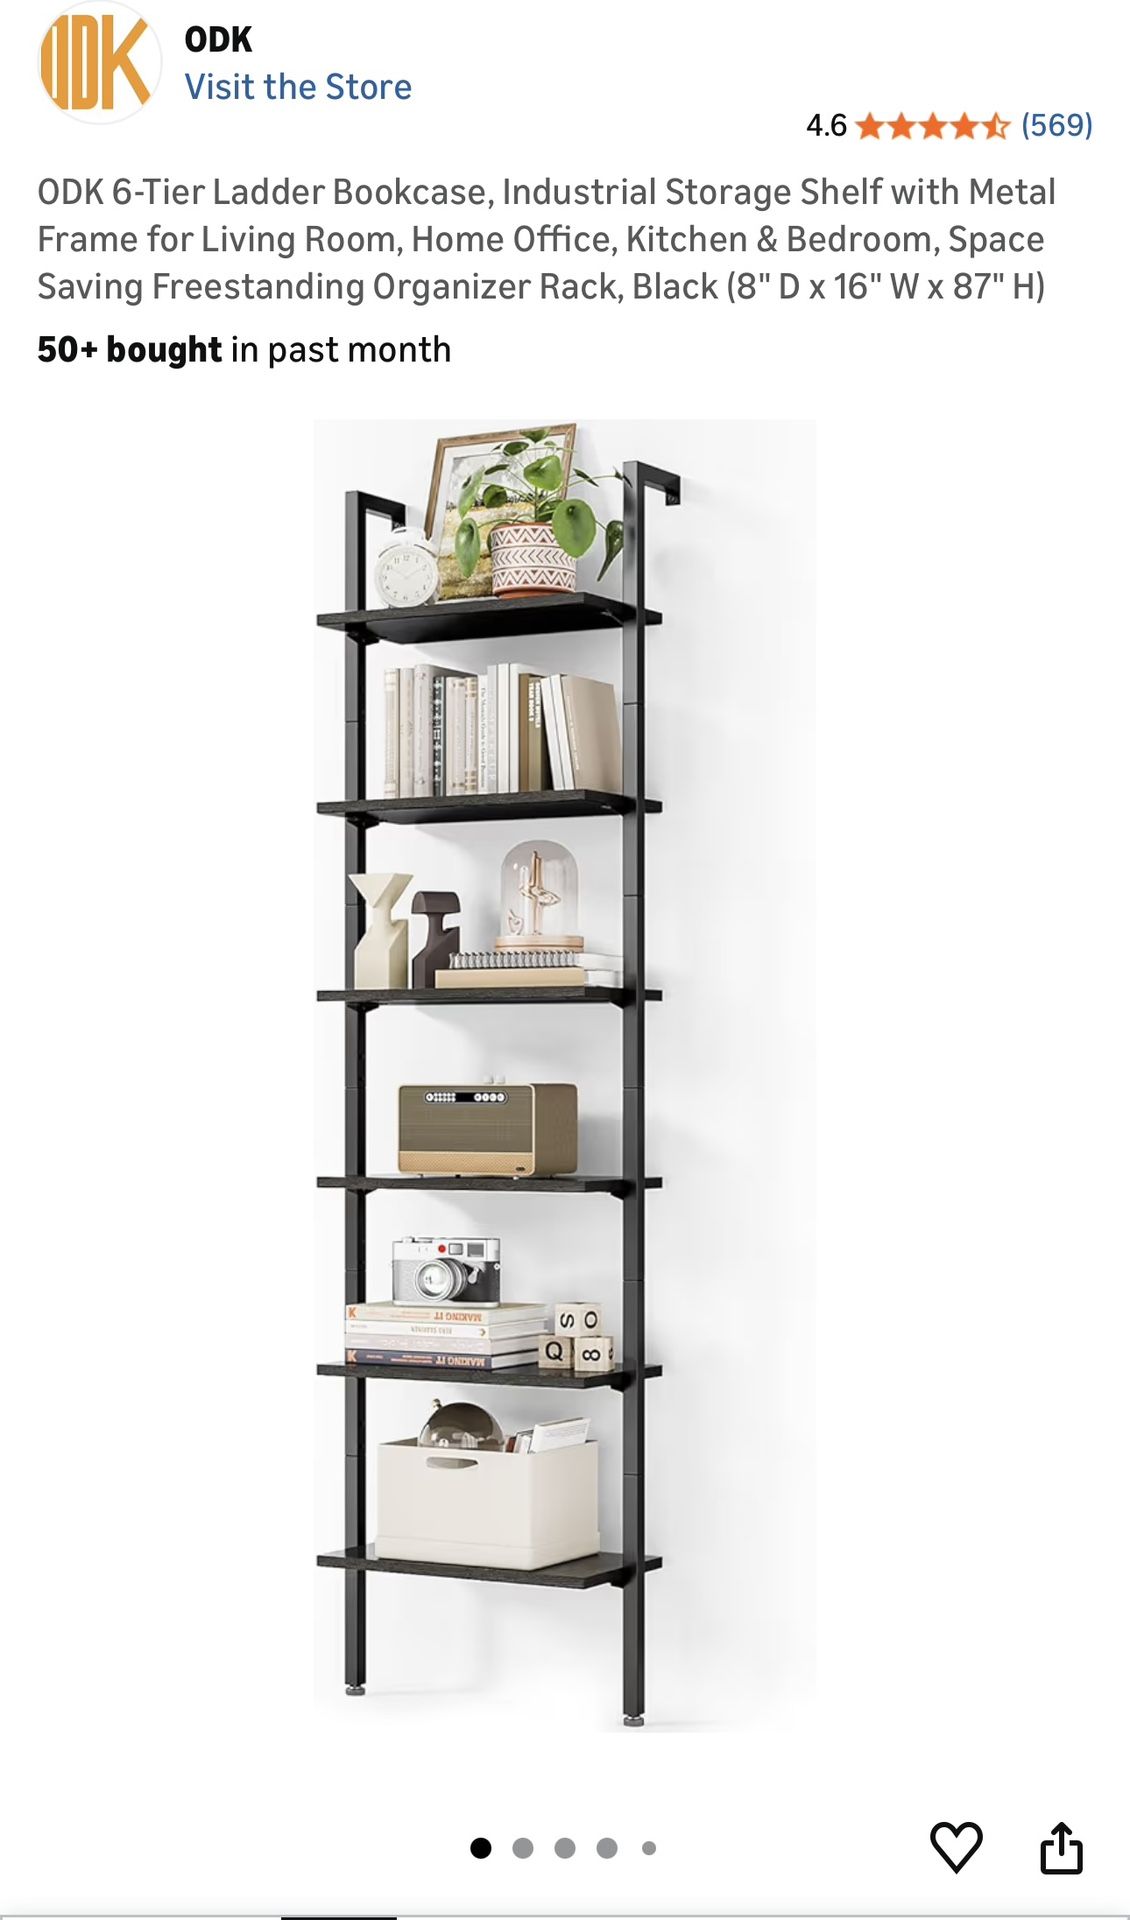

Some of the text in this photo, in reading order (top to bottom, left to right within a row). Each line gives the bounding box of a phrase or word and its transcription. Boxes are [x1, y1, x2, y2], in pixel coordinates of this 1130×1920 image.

[185, 25, 253, 53] ODK
[41, 15, 151, 110] ODK
[185, 72, 411, 100] Visit the Store
[806, 113, 847, 138] 4.6
[1022, 111, 1093, 141] (569)
[38, 177, 1056, 211] ODK 6-Tier Ladder Bookcase, Industrial Storage Shelf with Metal
[39, 224, 1044, 259] Frame for Living Room, Home Office, Kitchen & Bedroom, Space
[38, 271, 1044, 306] Saving Freestanding Organizer Rack, Black (8" D x 16" W x 87" H)
[38, 335, 450, 369] 50+ bought in past month
[348, 1306, 357, 1318] K
[433, 1311, 444, 1321] IT
[446, 1312, 483, 1322] MAKING
[347, 1349, 358, 1363] K
[435, 1354, 446, 1365] IT
[447, 1356, 486, 1367] MAKING
[545, 1341, 563, 1362] Q
[582, 1349, 601, 1361] 8
